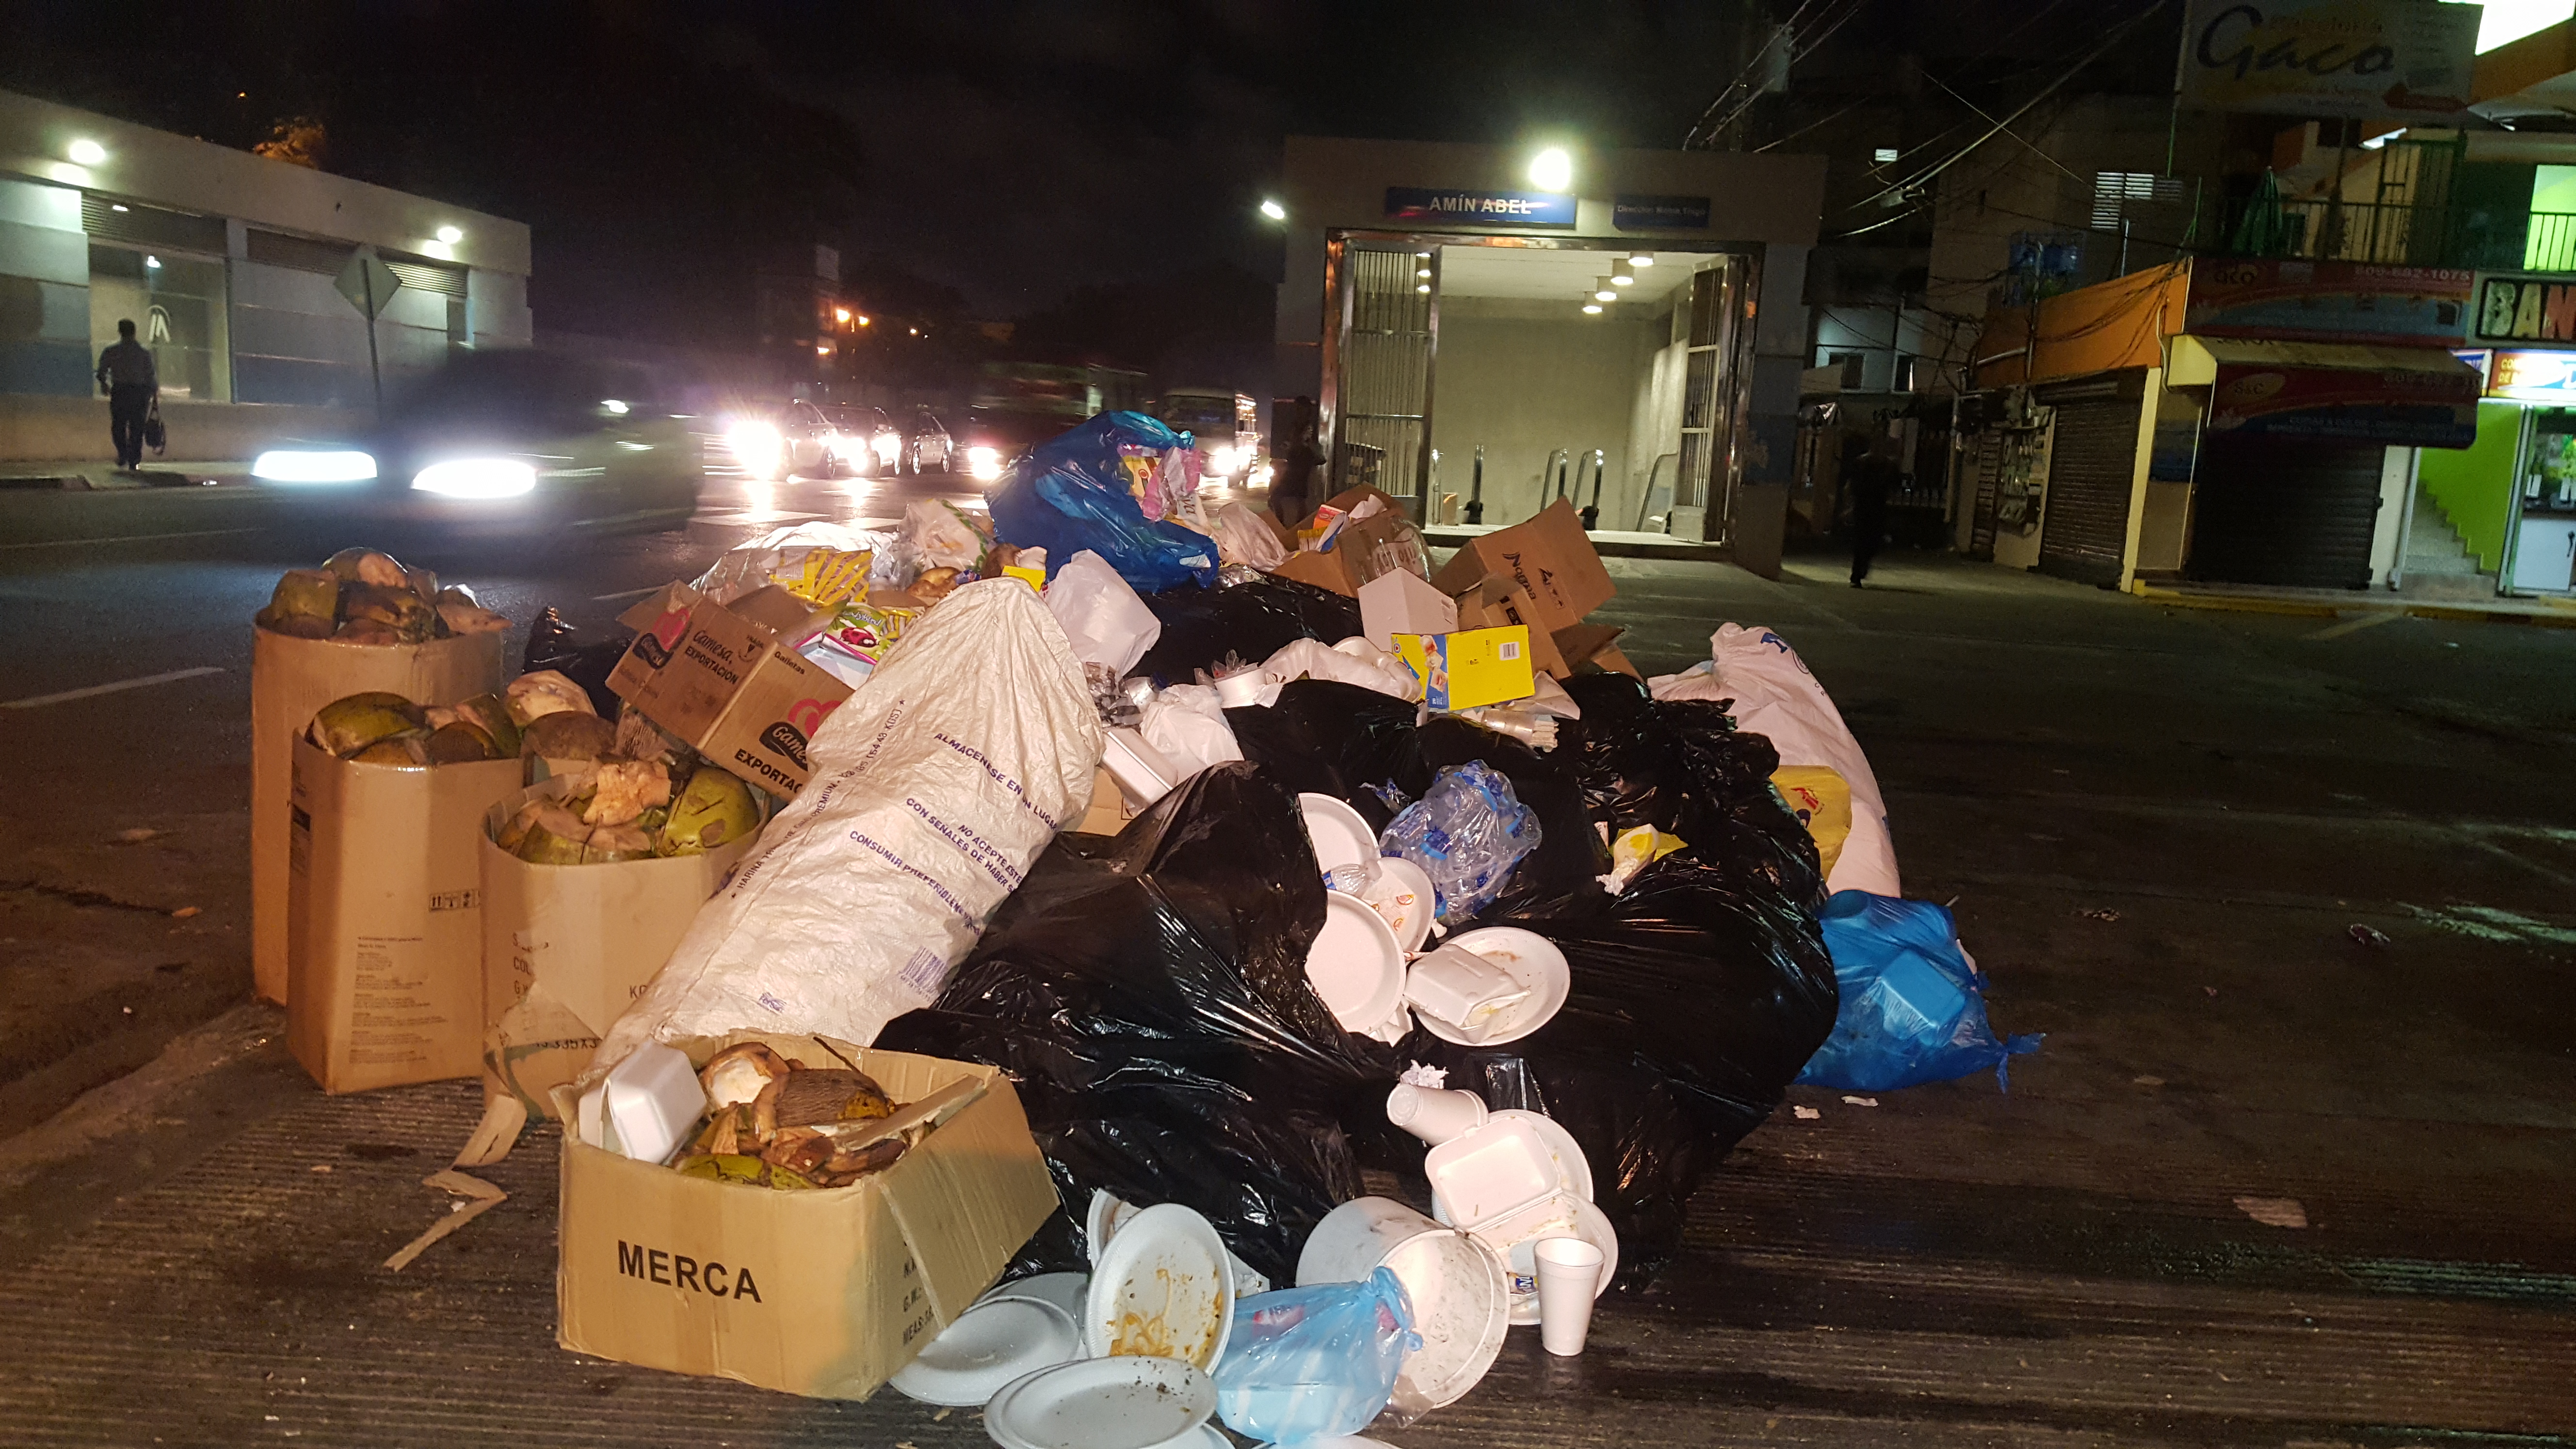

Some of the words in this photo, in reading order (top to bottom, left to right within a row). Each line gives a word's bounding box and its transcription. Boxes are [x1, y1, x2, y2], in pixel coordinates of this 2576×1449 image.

[1429, 194, 1476, 212] AMÍN
[1481, 199, 1532, 214] ABEL
[774, 651, 805, 675] Galletas
[1006, 779, 1023, 795] EN
[849, 830, 903, 868] CONSUMIR
[905, 797, 929, 818] CON
[970, 849, 985, 863] DE
[958, 825, 974, 838] NO
[971, 836, 1008, 868] ACEPTE
[1004, 864, 1022, 884] ESTE
[617, 1239, 762, 1304] MERCA
